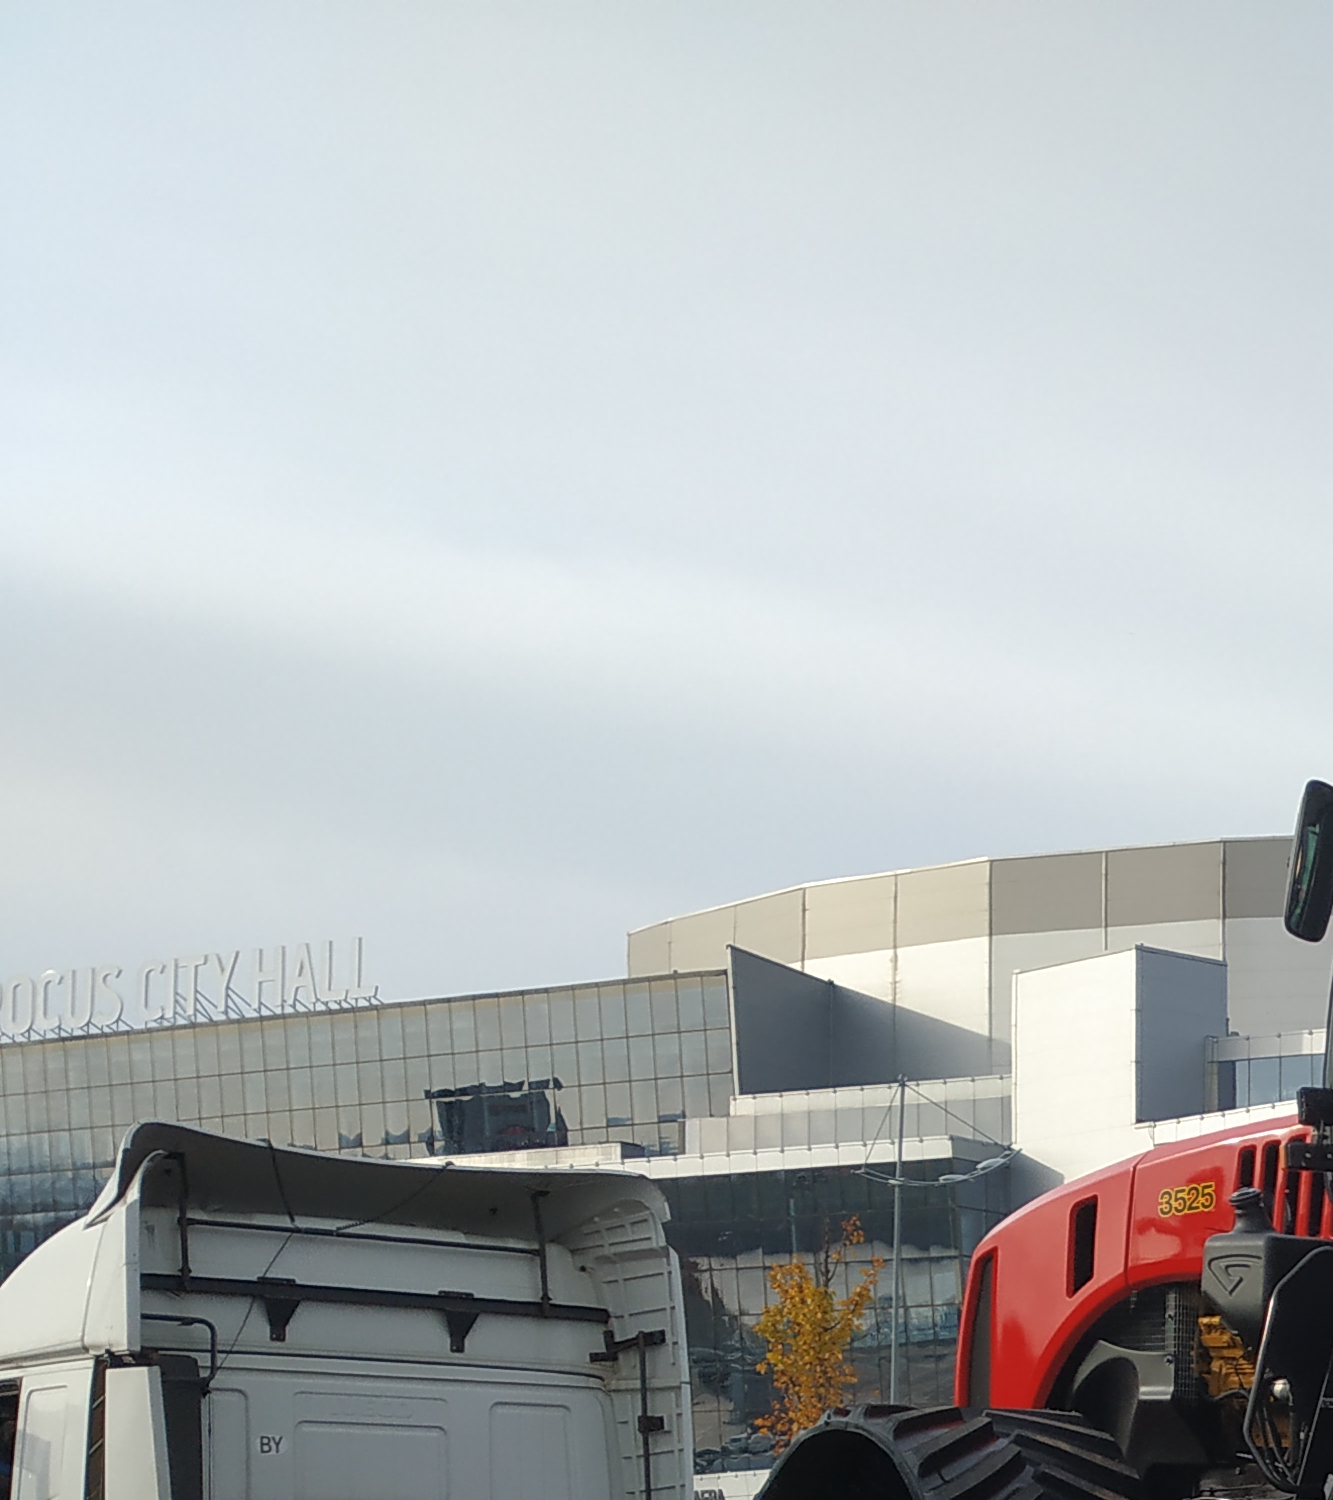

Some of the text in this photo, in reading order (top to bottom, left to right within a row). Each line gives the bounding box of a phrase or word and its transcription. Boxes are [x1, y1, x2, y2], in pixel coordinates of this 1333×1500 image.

[0, 935, 379, 1035] OCUS CITY HALL
[1158, 1182, 1217, 1217] 3525
[260, 1435, 283, 1454] BY
